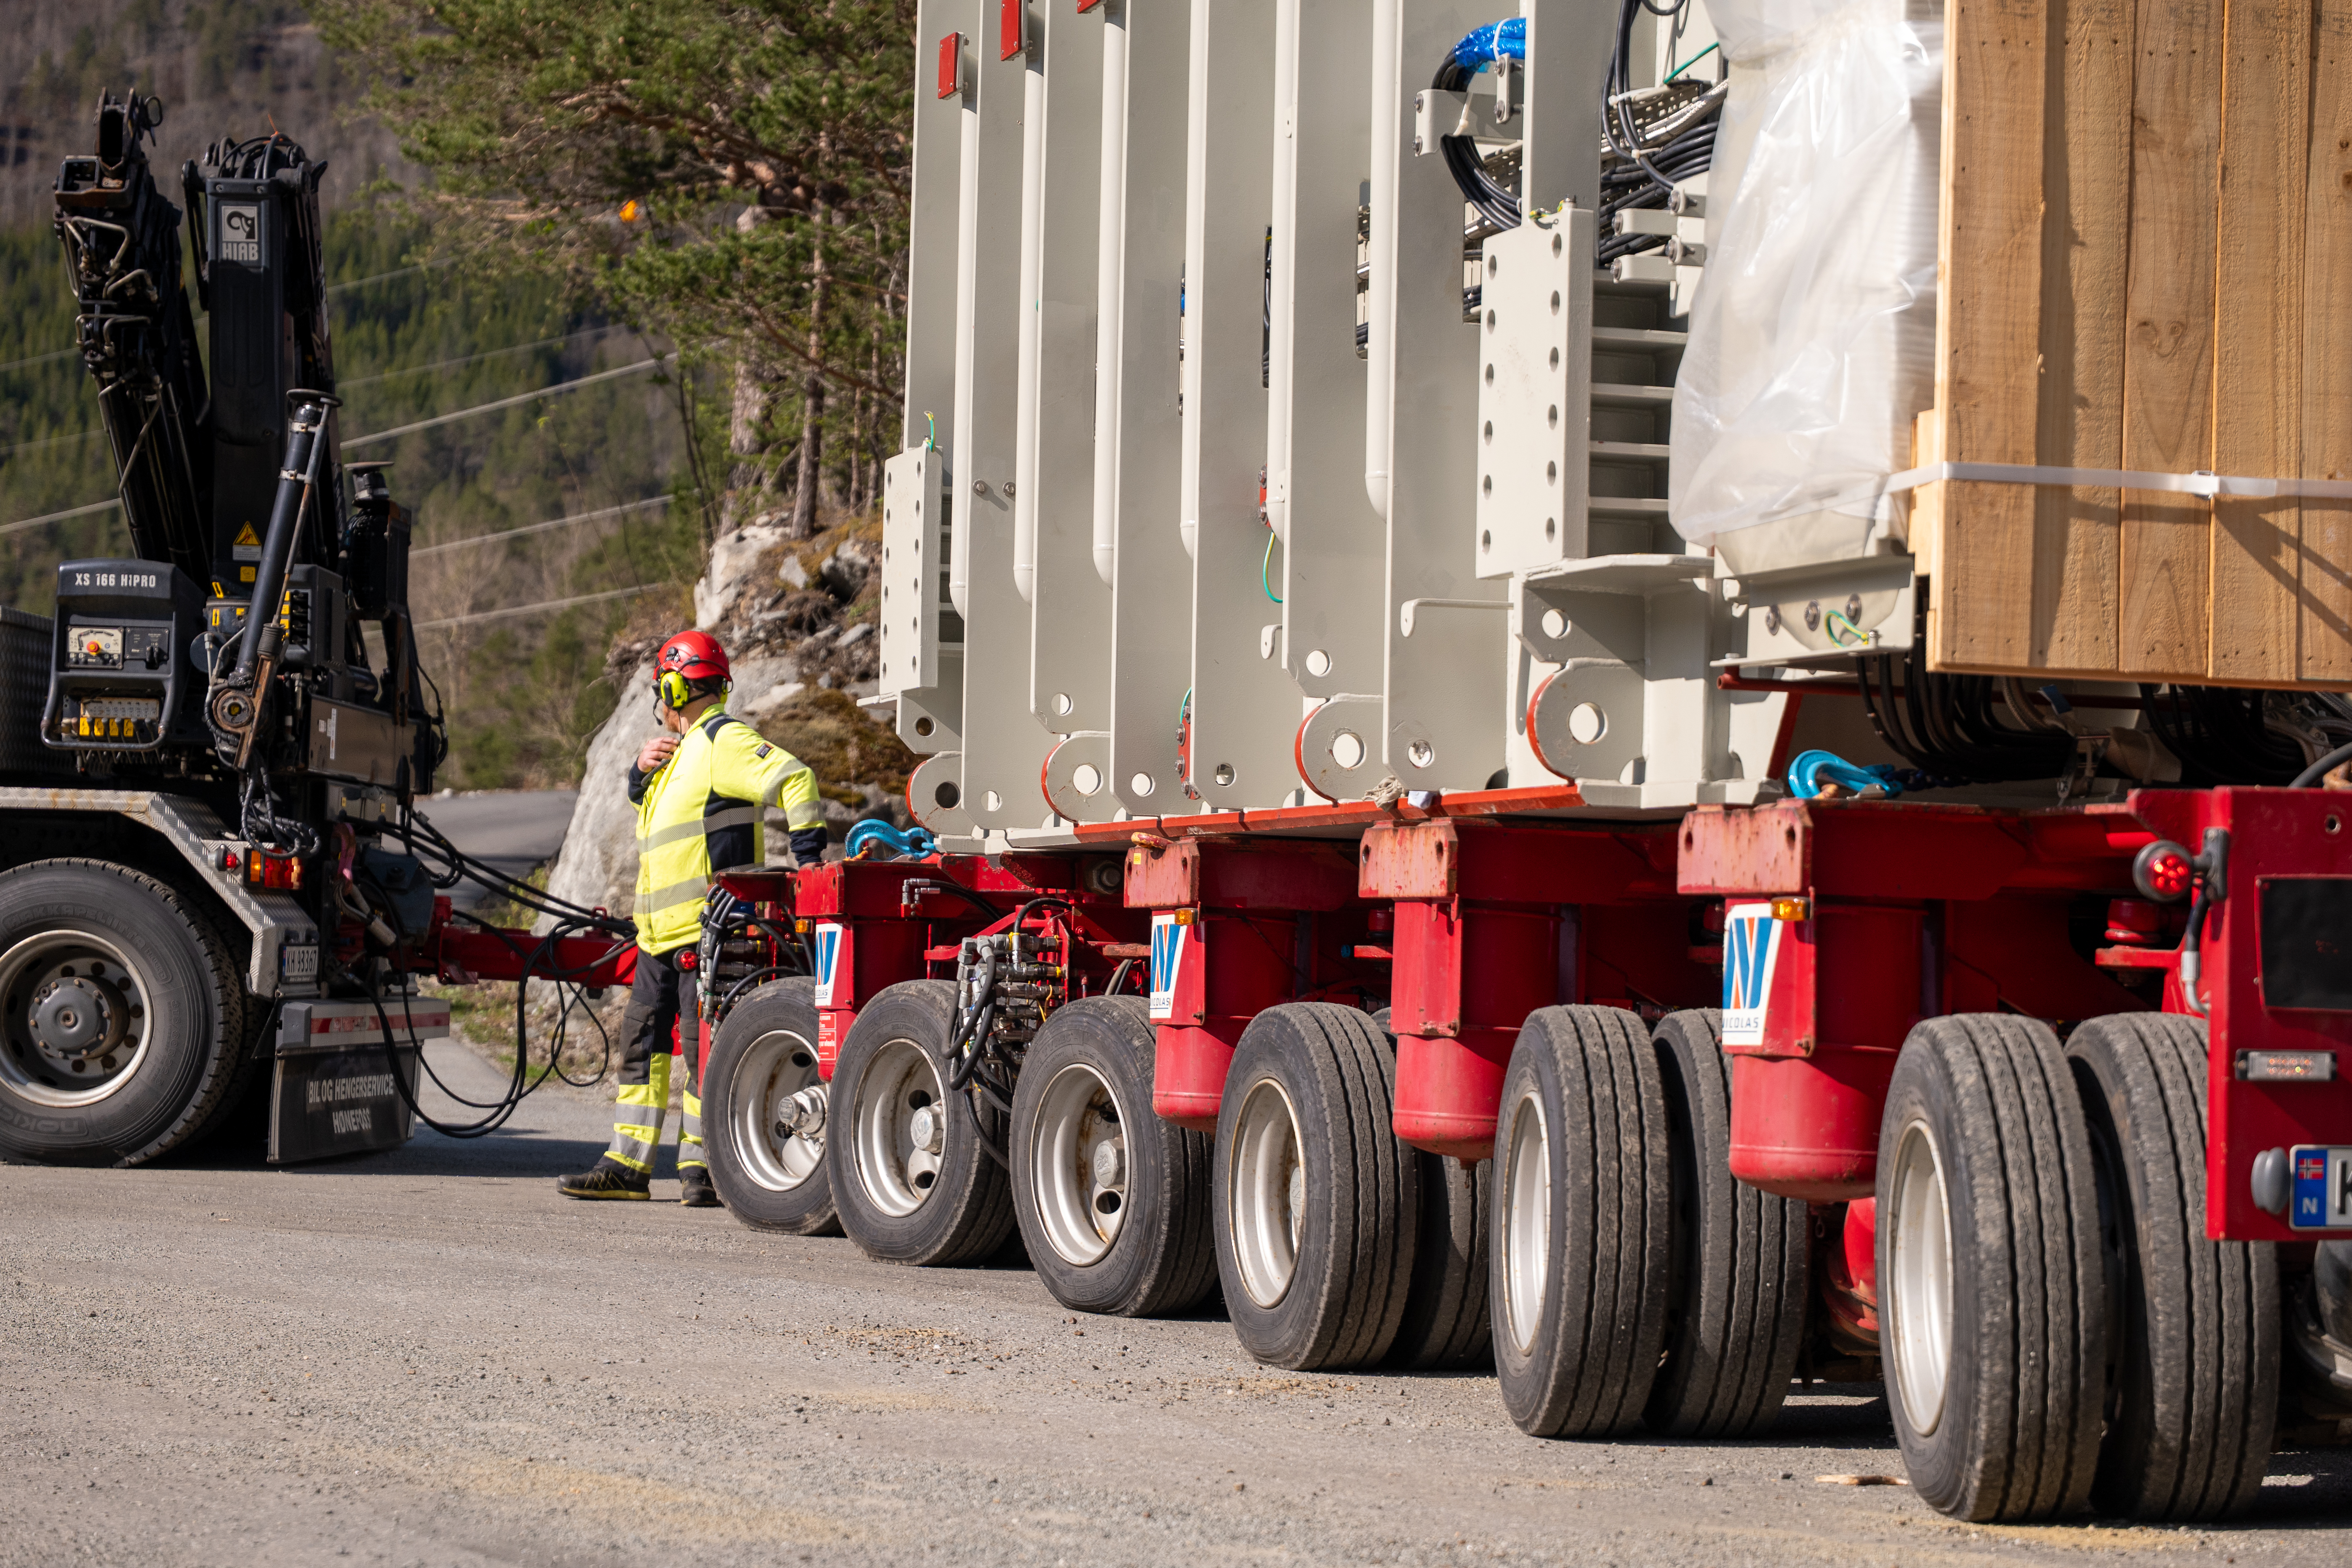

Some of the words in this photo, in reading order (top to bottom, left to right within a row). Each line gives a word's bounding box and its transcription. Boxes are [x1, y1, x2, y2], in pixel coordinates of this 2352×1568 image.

[222, 242, 258, 260] HIAB
[75, 573, 90, 586] XS
[96, 573, 115, 587] 166
[286, 950, 295, 973] KH
[297, 949, 317, 972] 93367
[309, 1081, 320, 1103] BIL
[321, 1079, 333, 1102] OG
[335, 1074, 394, 1100] HENGERSERVICE
[333, 1108, 371, 1133] HØNEFOSS
[2302, 1197, 2317, 1215] N
